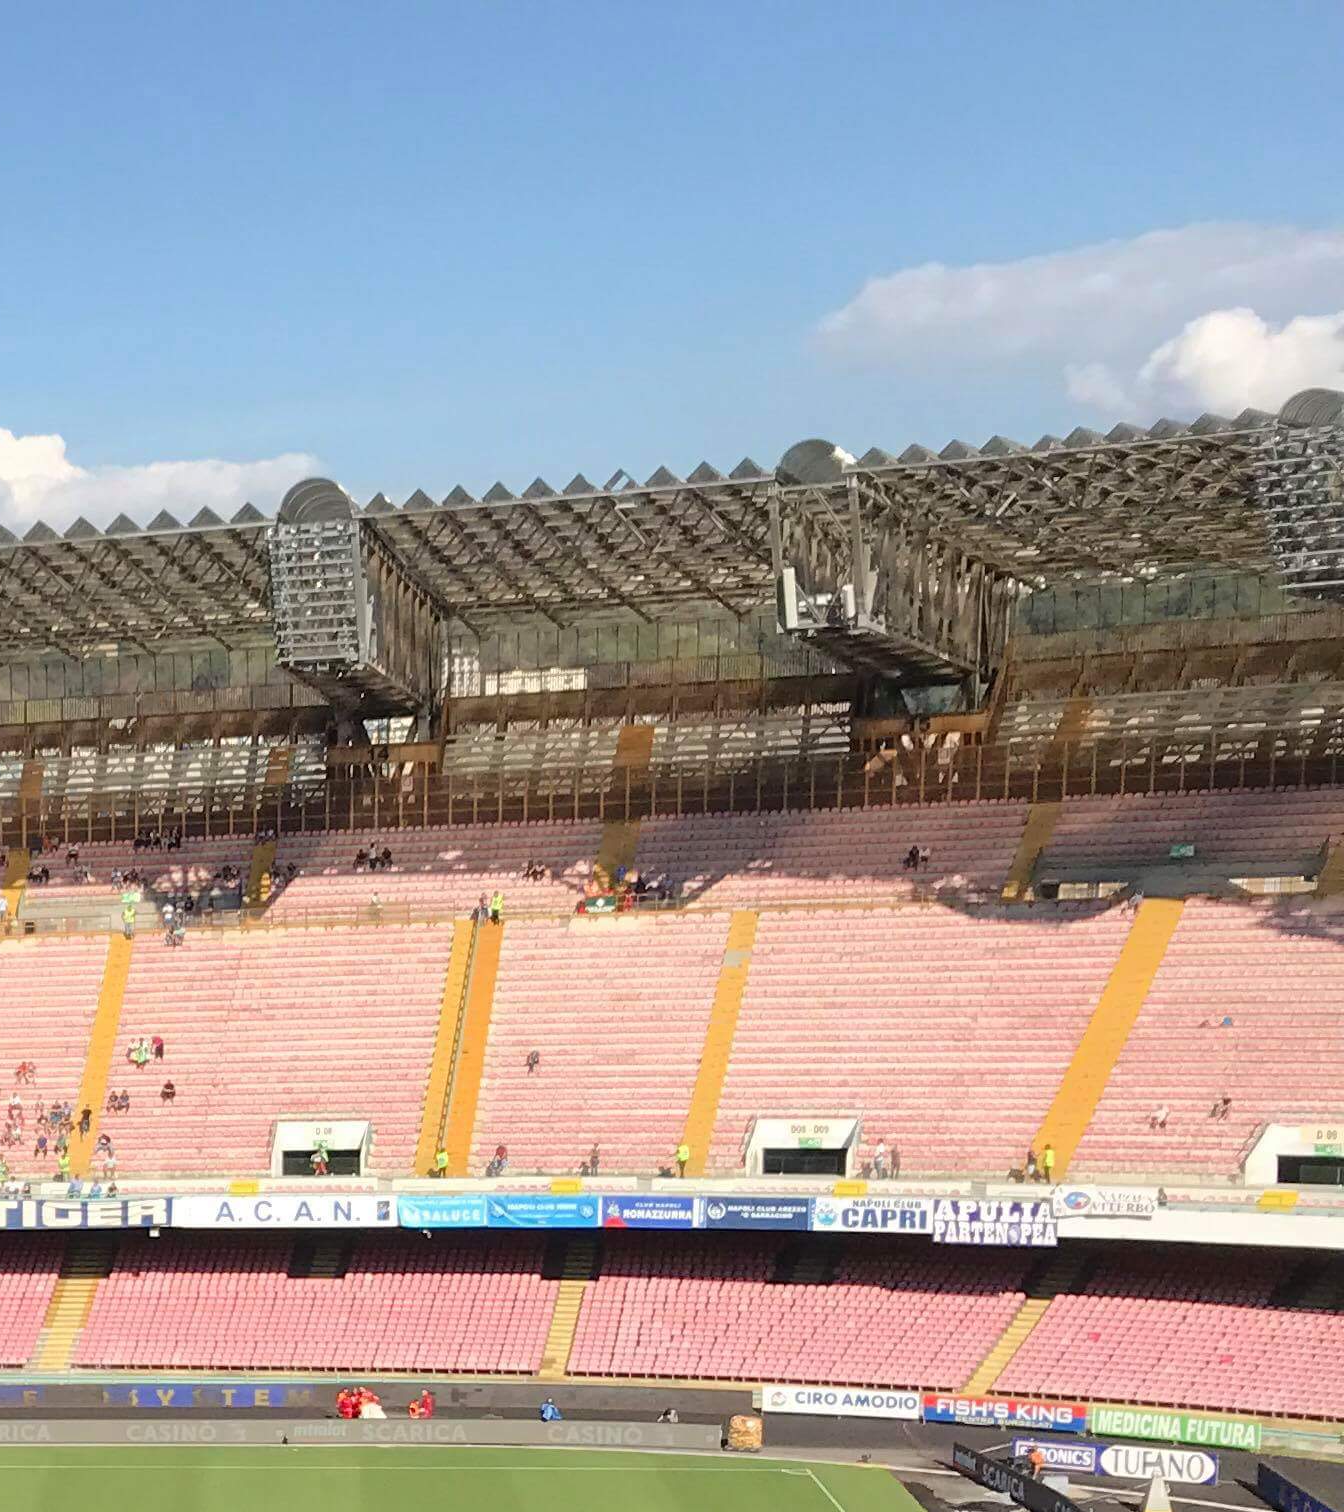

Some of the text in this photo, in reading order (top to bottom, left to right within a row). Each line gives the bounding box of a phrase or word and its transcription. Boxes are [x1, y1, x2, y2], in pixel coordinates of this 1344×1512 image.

[841, 1208, 927, 1230] CAPRI
[934, 1200, 1057, 1223] APULIA
[795, 1391, 918, 1410] CIRO AMODIO
[936, 1398, 1074, 1424] FISH'S KING
[362, 1424, 467, 1441] SCARICA
[1098, 1409, 1258, 1449] MEDICINA FUTURA
[1111, 1447, 1205, 1481] TUFANO
